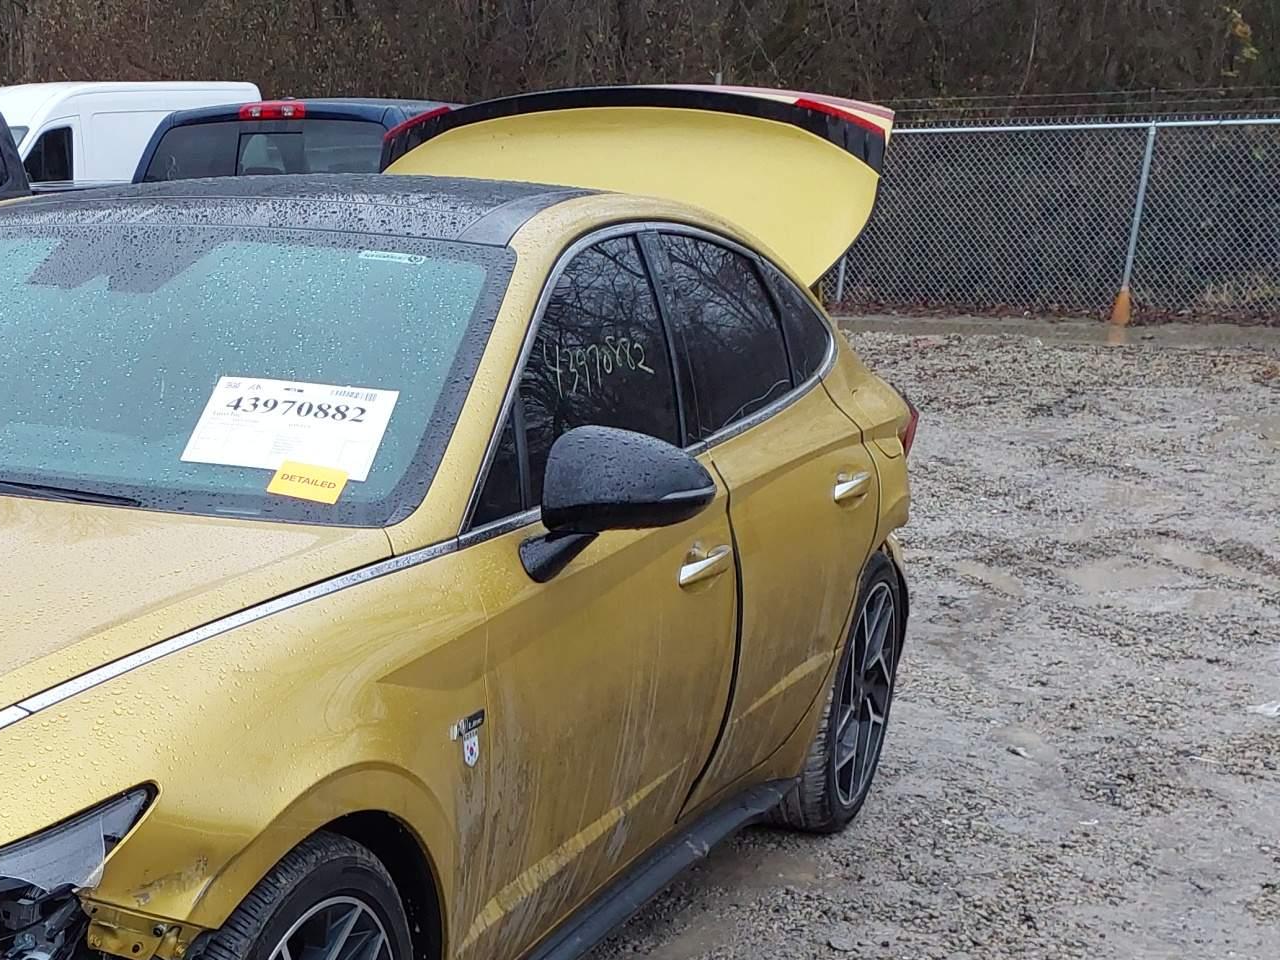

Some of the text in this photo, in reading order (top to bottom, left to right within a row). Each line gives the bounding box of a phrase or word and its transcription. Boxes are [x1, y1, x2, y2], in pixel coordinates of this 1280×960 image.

[543, 335, 655, 399] 43970882
[225, 396, 367, 424] 43970882
[280, 473, 337, 489] DETAILED
